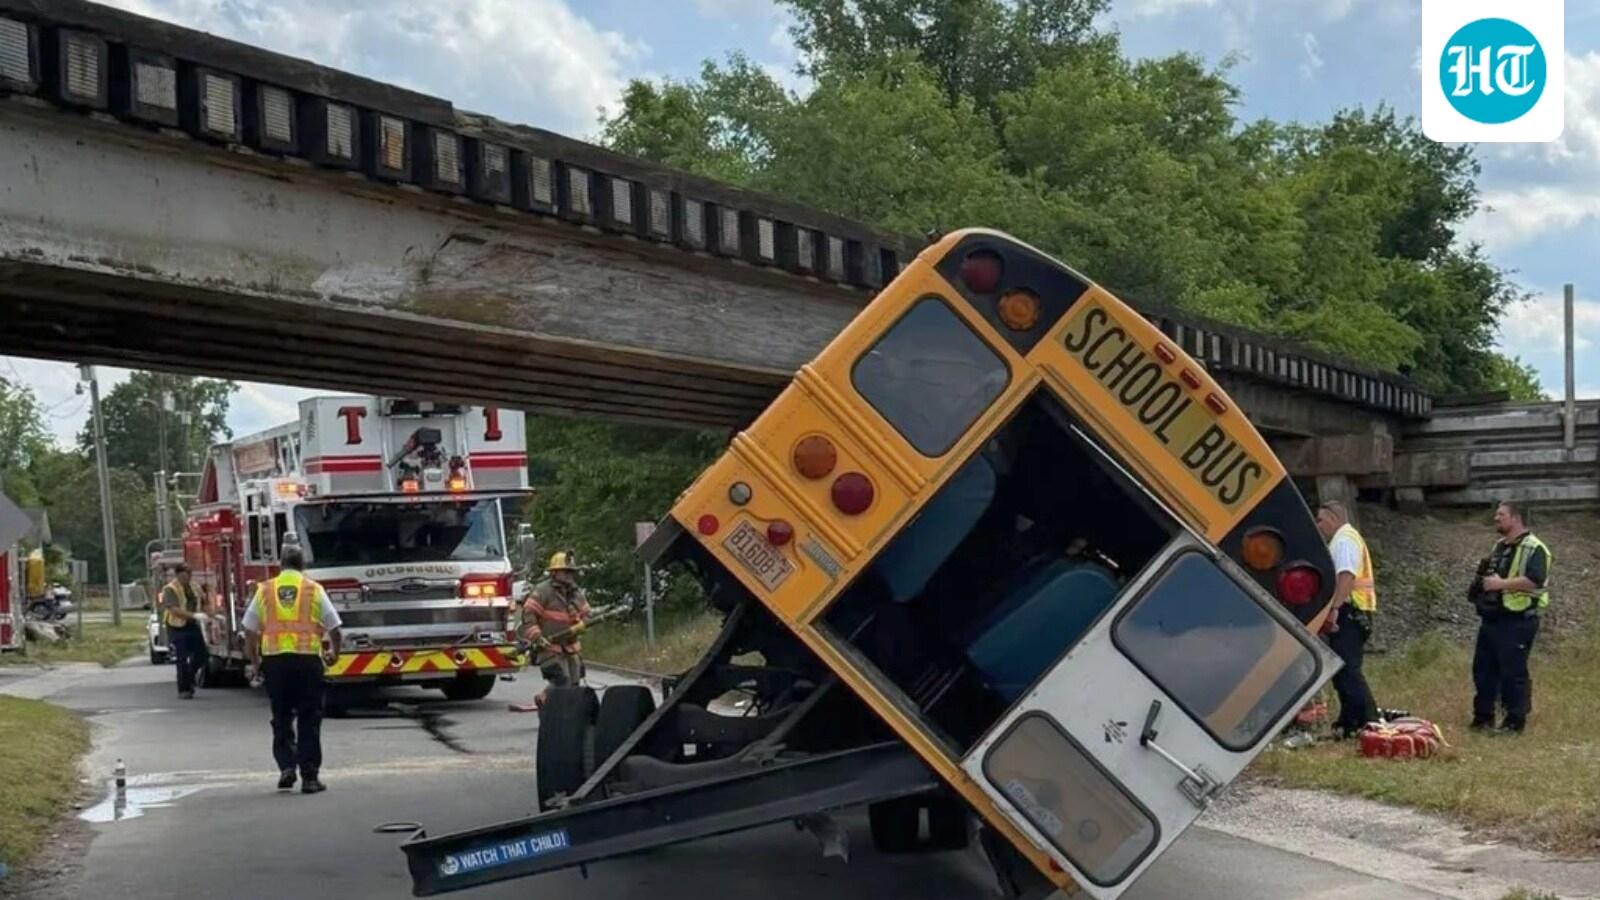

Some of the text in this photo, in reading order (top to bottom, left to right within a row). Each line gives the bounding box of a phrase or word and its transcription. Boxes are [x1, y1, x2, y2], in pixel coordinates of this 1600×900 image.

[338, 406, 366, 444] T
[1064, 307, 1262, 505] SCHOOL BUS
[460, 833, 567, 869] WATCH THAT CHILD!
